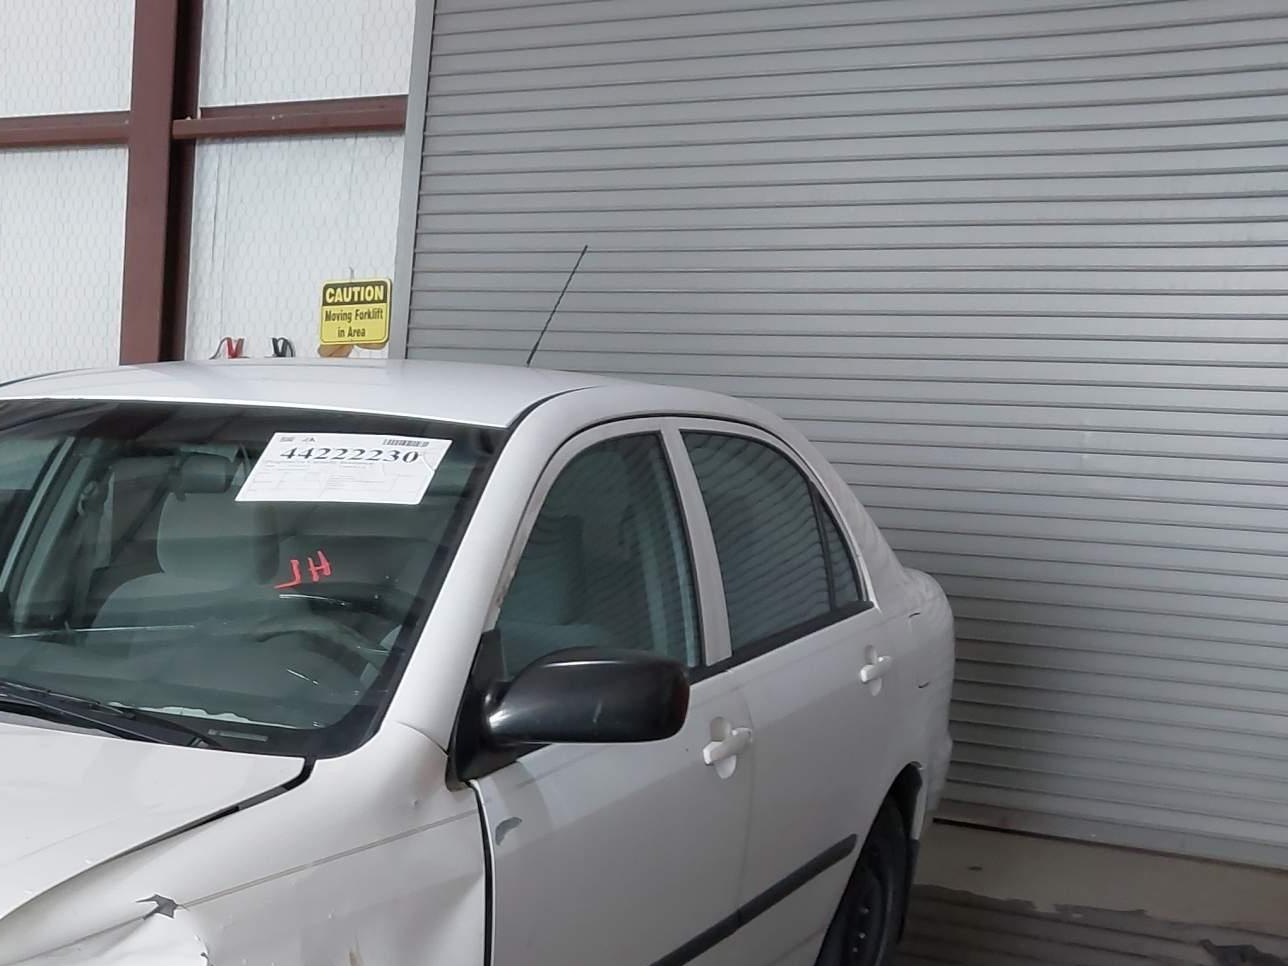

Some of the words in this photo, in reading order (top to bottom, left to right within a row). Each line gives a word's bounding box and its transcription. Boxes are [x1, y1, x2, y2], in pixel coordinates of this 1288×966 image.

[325, 285, 384, 303] CAUTION
[324, 309, 352, 323] Moving
[355, 307, 384, 320] Forklift
[337, 326, 345, 337] in
[347, 326, 366, 337] Area
[280, 446, 419, 464] 44222230
